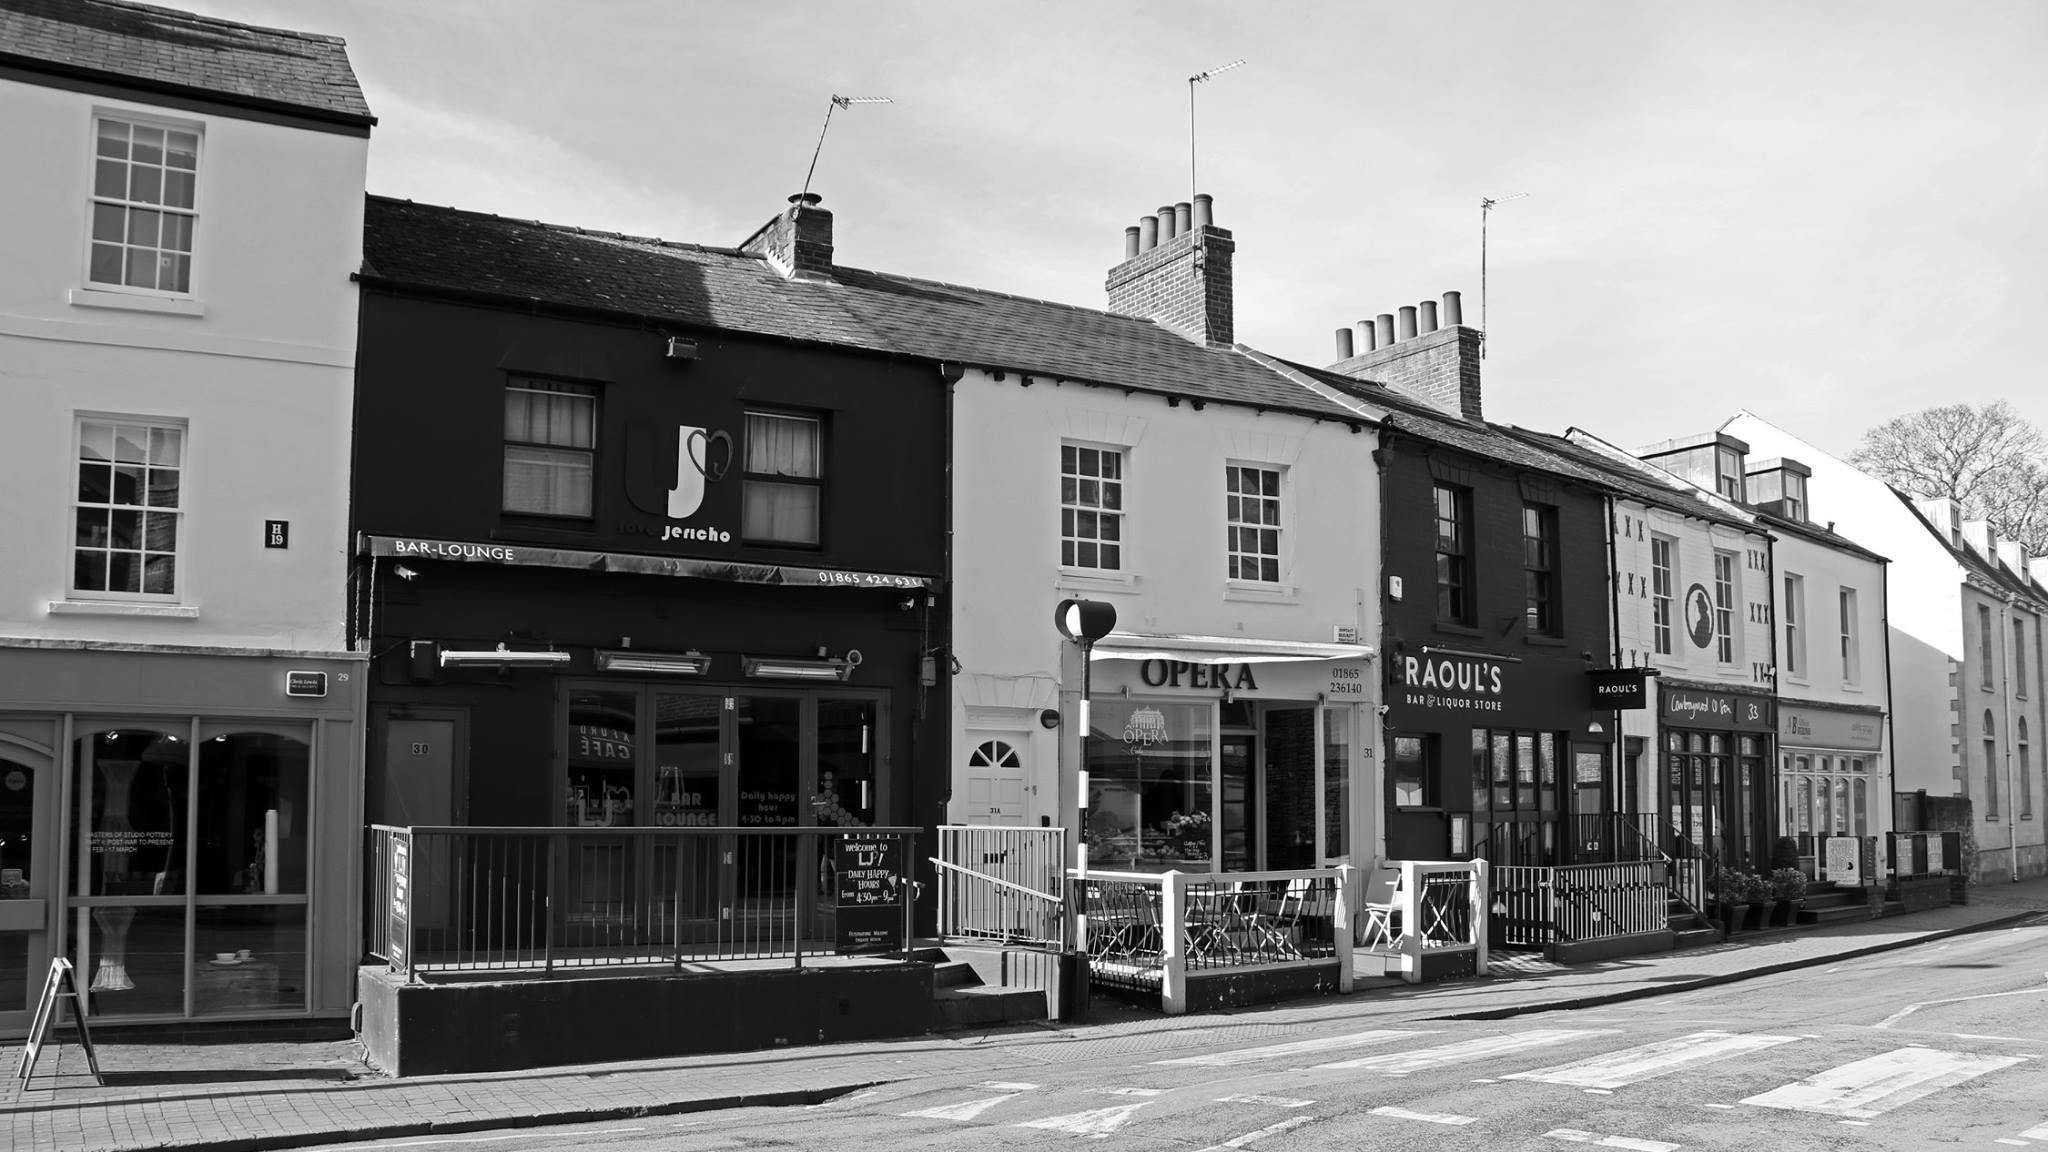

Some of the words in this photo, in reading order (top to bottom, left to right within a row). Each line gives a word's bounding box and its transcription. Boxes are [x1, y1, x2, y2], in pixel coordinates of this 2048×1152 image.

[272, 524, 282, 534] H
[661, 525, 731, 543] jericho
[271, 534, 284, 545] 19
[395, 540, 514, 560] BAR-LOUNGE
[819, 571, 860, 583] 01865
[865, 576, 888, 585] 424
[895, 576, 918, 586] 631
[337, 672, 349, 682] 29
[1141, 659, 1259, 690] OPERA
[1332, 667, 1360, 679] 01865
[1406, 656, 1501, 693] RAOUL'S
[1330, 682, 1362, 694] 236140
[1598, 684, 1638, 694] RAOUL'S
[1407, 694, 1424, 704] BAR
[1427, 694, 1435, 707] &
[1437, 697, 1470, 709] LIQUOR
[1475, 700, 1502, 711] STORE
[1747, 703, 1759, 721] 33
[413, 744, 428, 754] 30
[1364, 747, 1372, 758] 31
[672, 792, 701, 806] BAR
[741, 791, 765, 802] Daily
[768, 791, 795, 802] happy
[656, 812, 717, 826] LOUNGE
[764, 814, 774, 823] to
[845, 842, 877, 852] welcome
[880, 842, 888, 851] to
[848, 870, 866, 879] DAILY
[867, 869, 889, 879] HAPPY
[858, 880, 880, 889] HOURS
